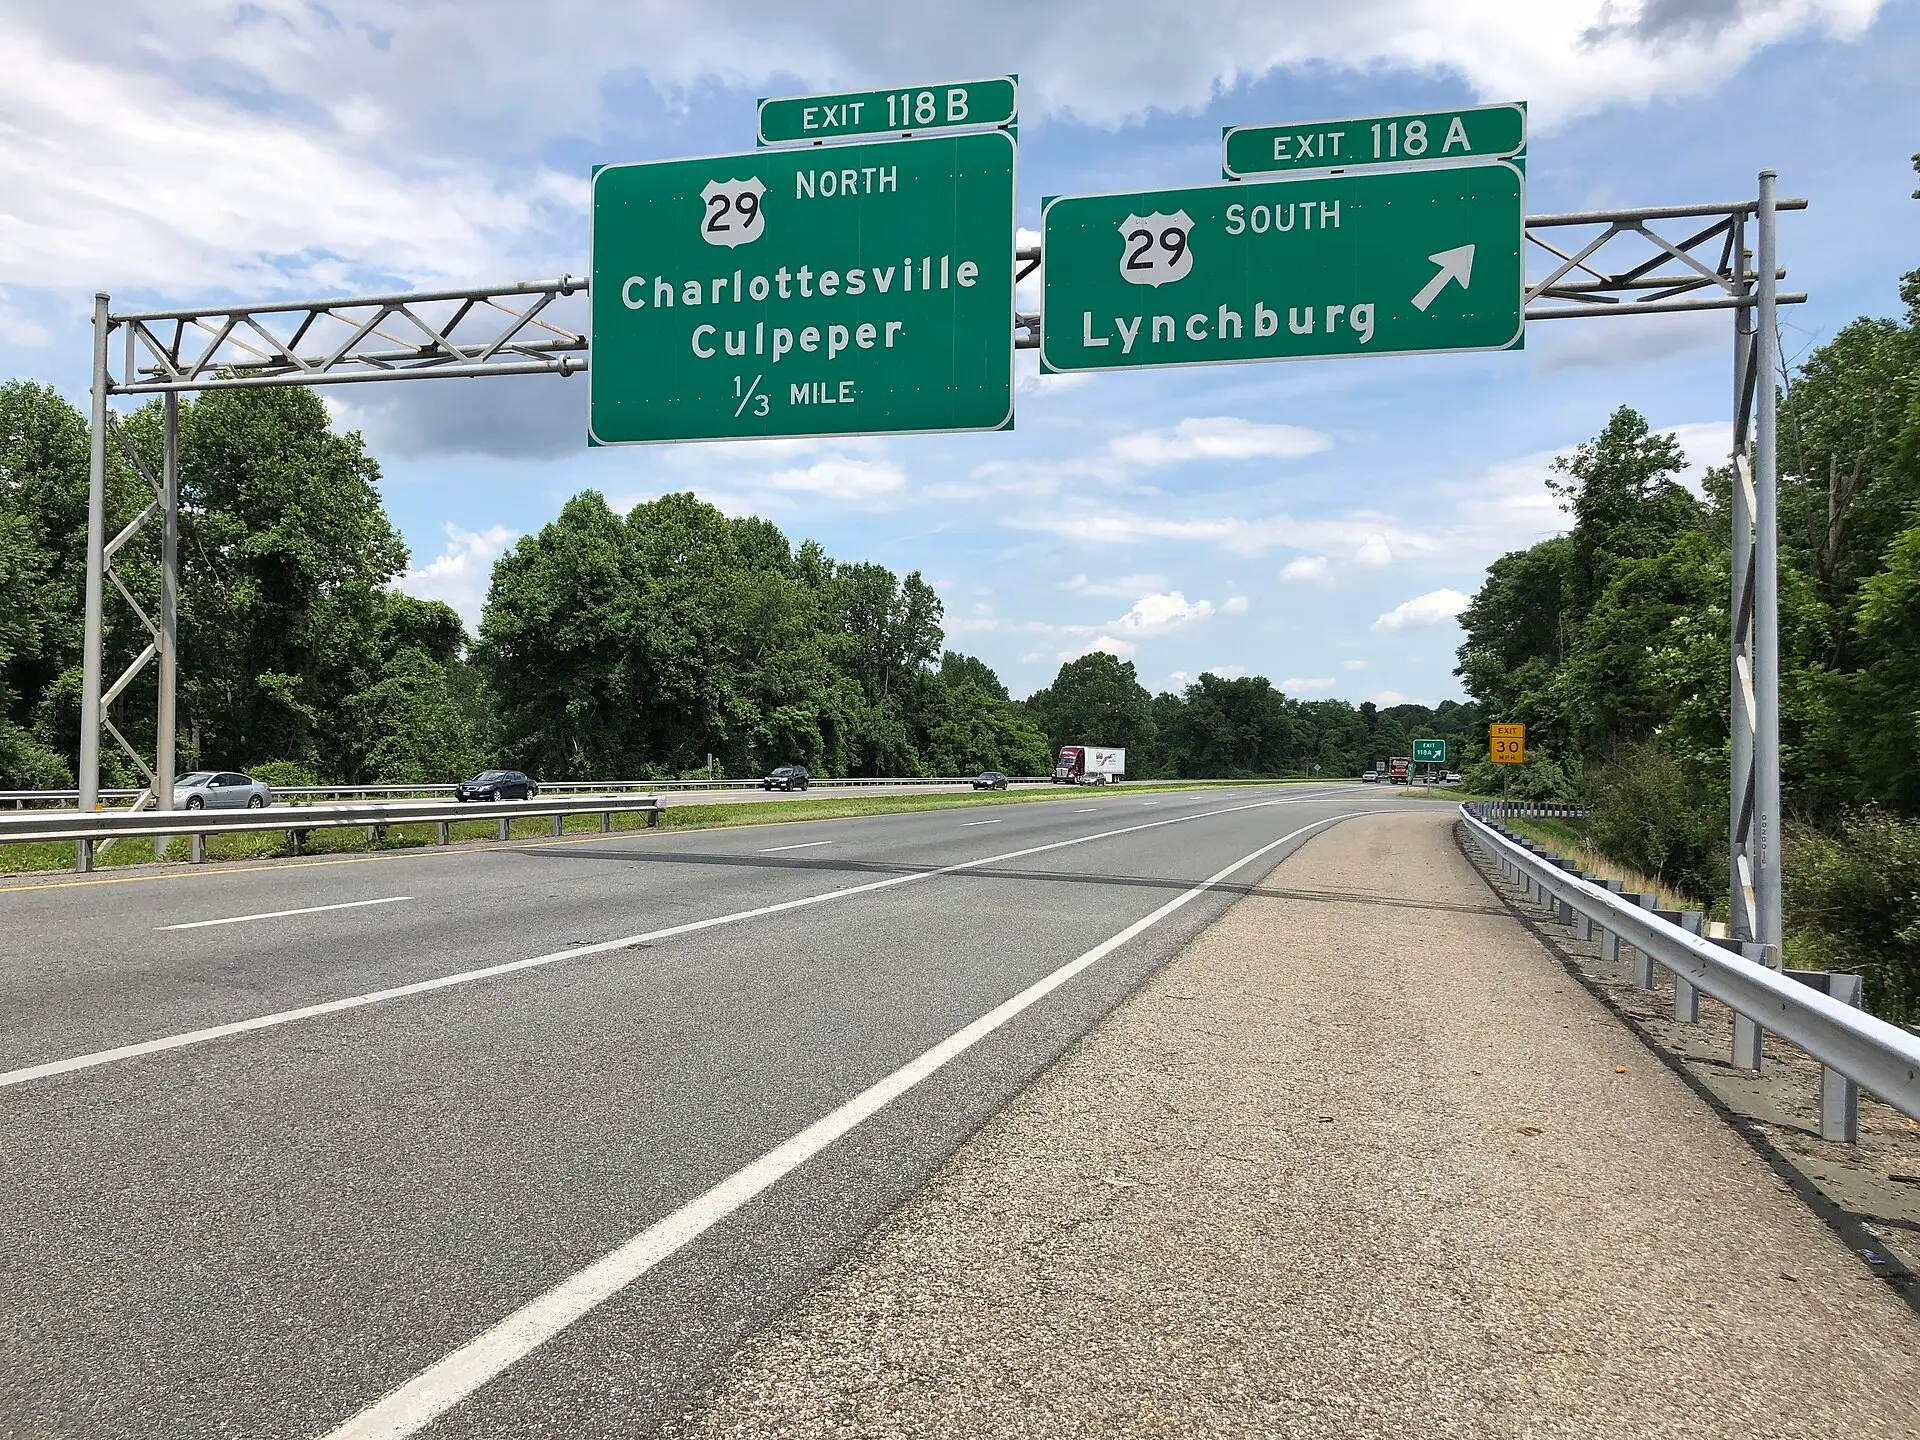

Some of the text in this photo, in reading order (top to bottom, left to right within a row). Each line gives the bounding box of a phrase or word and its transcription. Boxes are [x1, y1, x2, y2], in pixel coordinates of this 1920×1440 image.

[804, 89, 969, 130] EXIT 118 B
[1274, 117, 1471, 160] EXIT 118 A
[706, 166, 897, 232] 29 NORTH
[1126, 200, 1340, 270] 29 SOUTH
[622, 256, 979, 309] Charlottesville
[692, 321, 902, 362] Culpeper
[1083, 302, 1375, 355] Lynchburg
[734, 375, 854, 417] 1/3 MILE
[1496, 741, 1518, 753] 30
